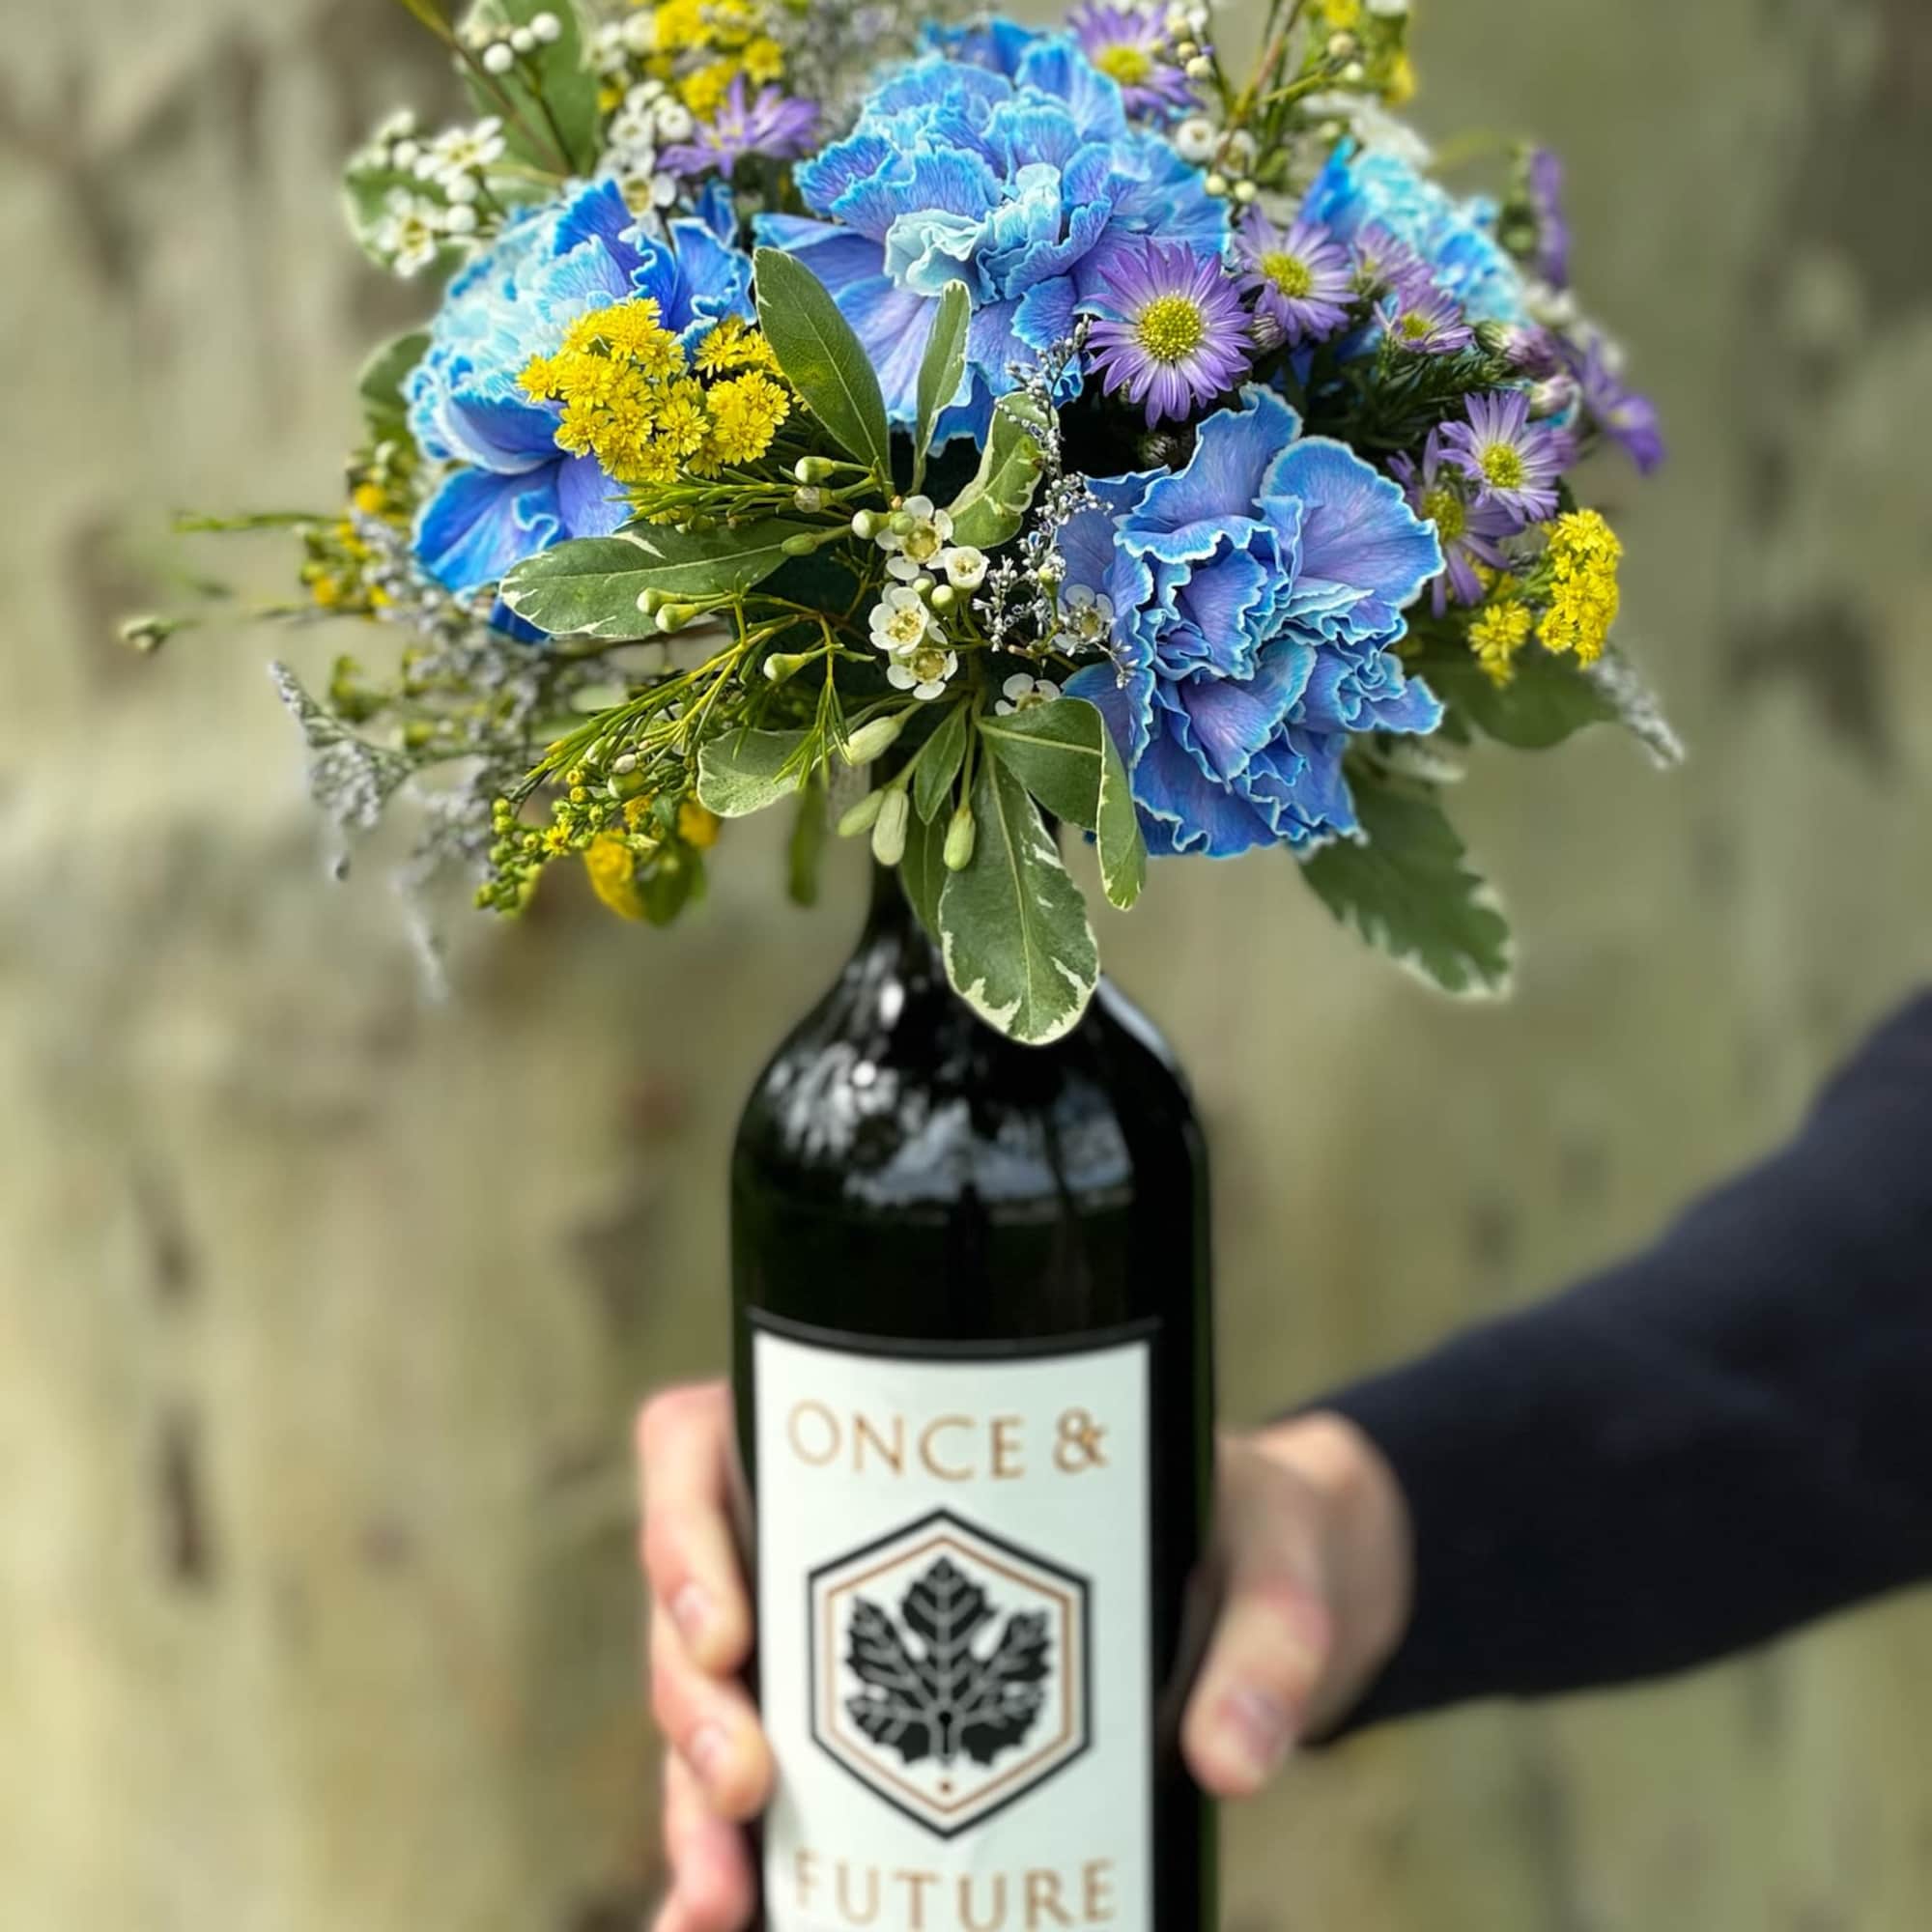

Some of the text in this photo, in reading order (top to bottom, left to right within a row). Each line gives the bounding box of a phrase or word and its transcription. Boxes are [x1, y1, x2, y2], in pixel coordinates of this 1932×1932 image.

[787, 1397, 1109, 1482] ONCE &
[794, 1846, 1116, 1932] FUTURE
